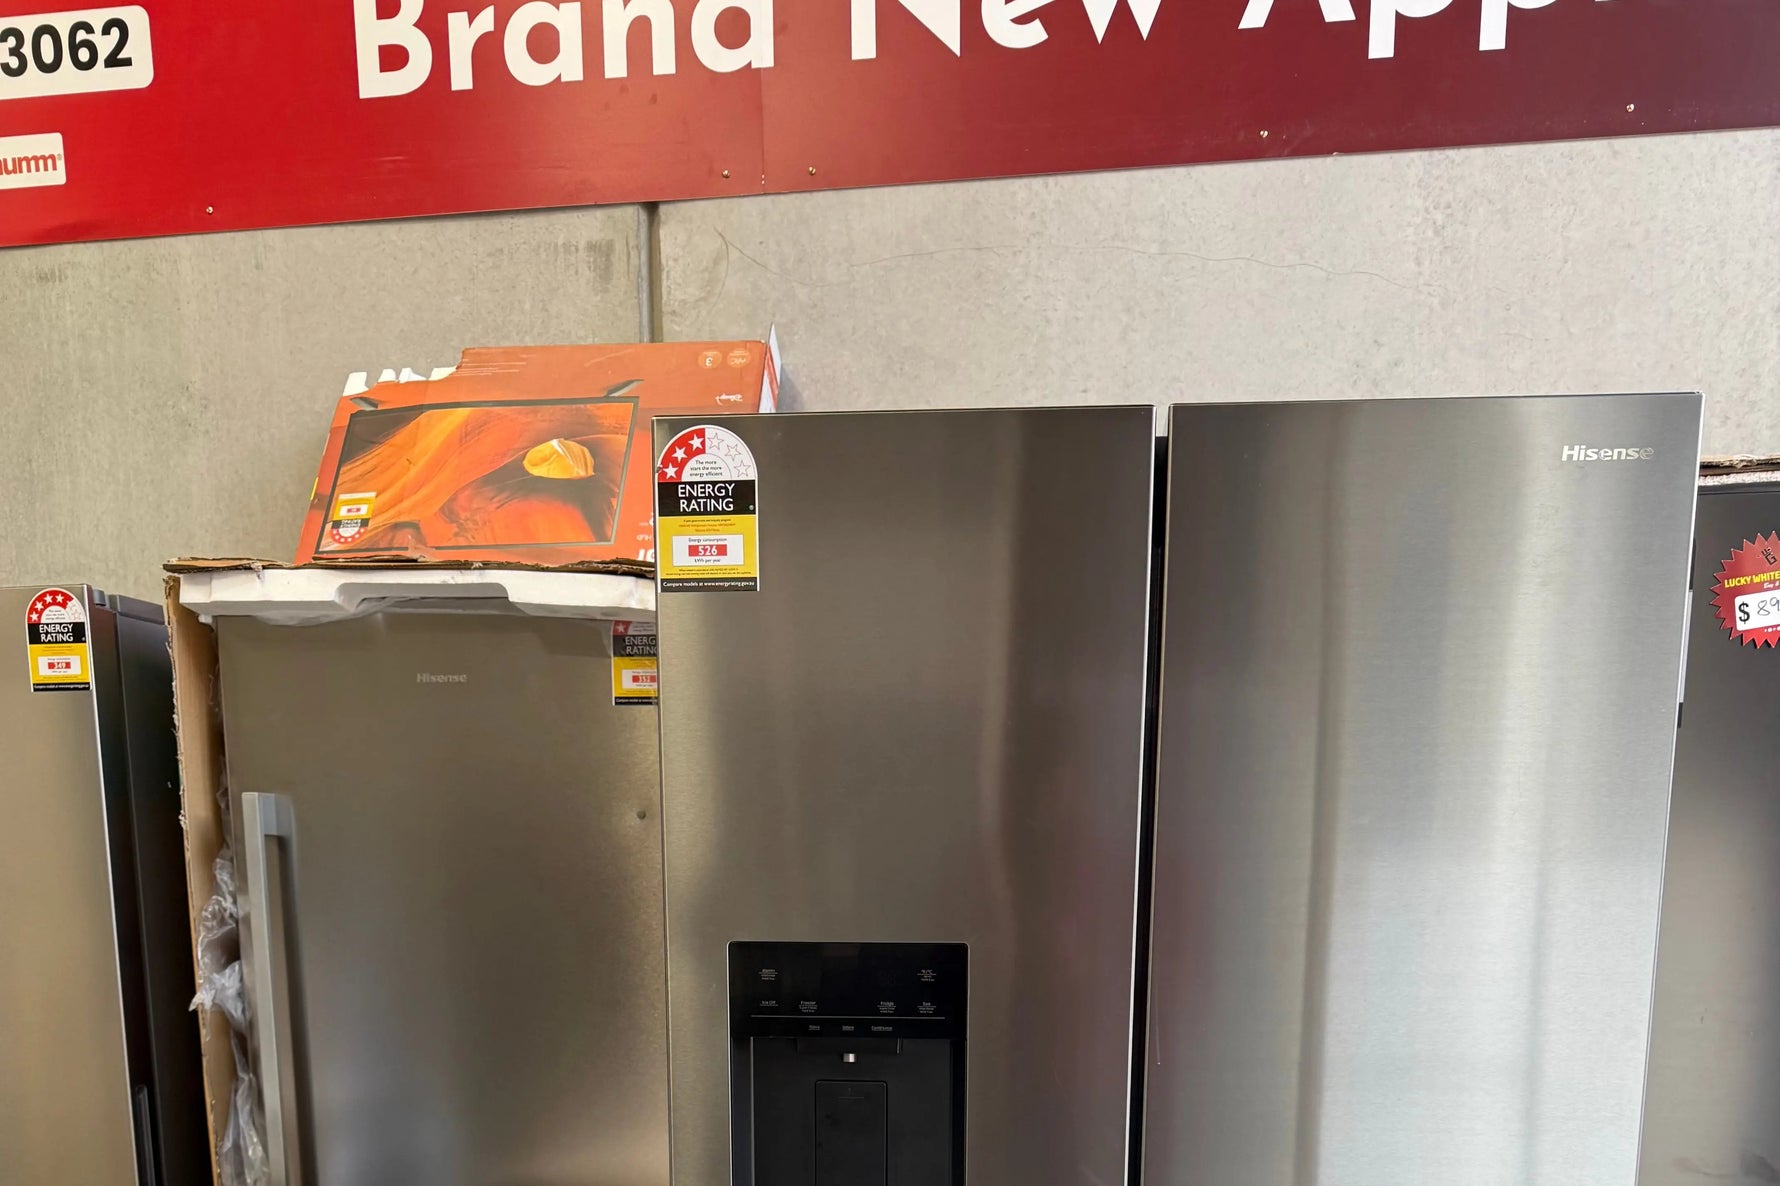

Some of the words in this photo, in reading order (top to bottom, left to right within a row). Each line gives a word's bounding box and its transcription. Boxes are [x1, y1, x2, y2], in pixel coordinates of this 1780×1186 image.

[0, 17, 133, 77] 3062
[353, 0, 774, 99] Brand
[0, 153, 58, 176] umm
[1561, 445, 1654, 461] Hisense
[678, 483, 735, 497] ENERGY
[680, 498, 734, 512] RATING
[698, 545, 718, 556] 526
[1724, 575, 1751, 588] LUCKY
[1738, 601, 1750, 625] $
[39, 624, 73, 633] ENERGY
[40, 633, 73, 642] RATING
[625, 636, 656, 645] ENERG
[417, 673, 468, 683] Hisense
